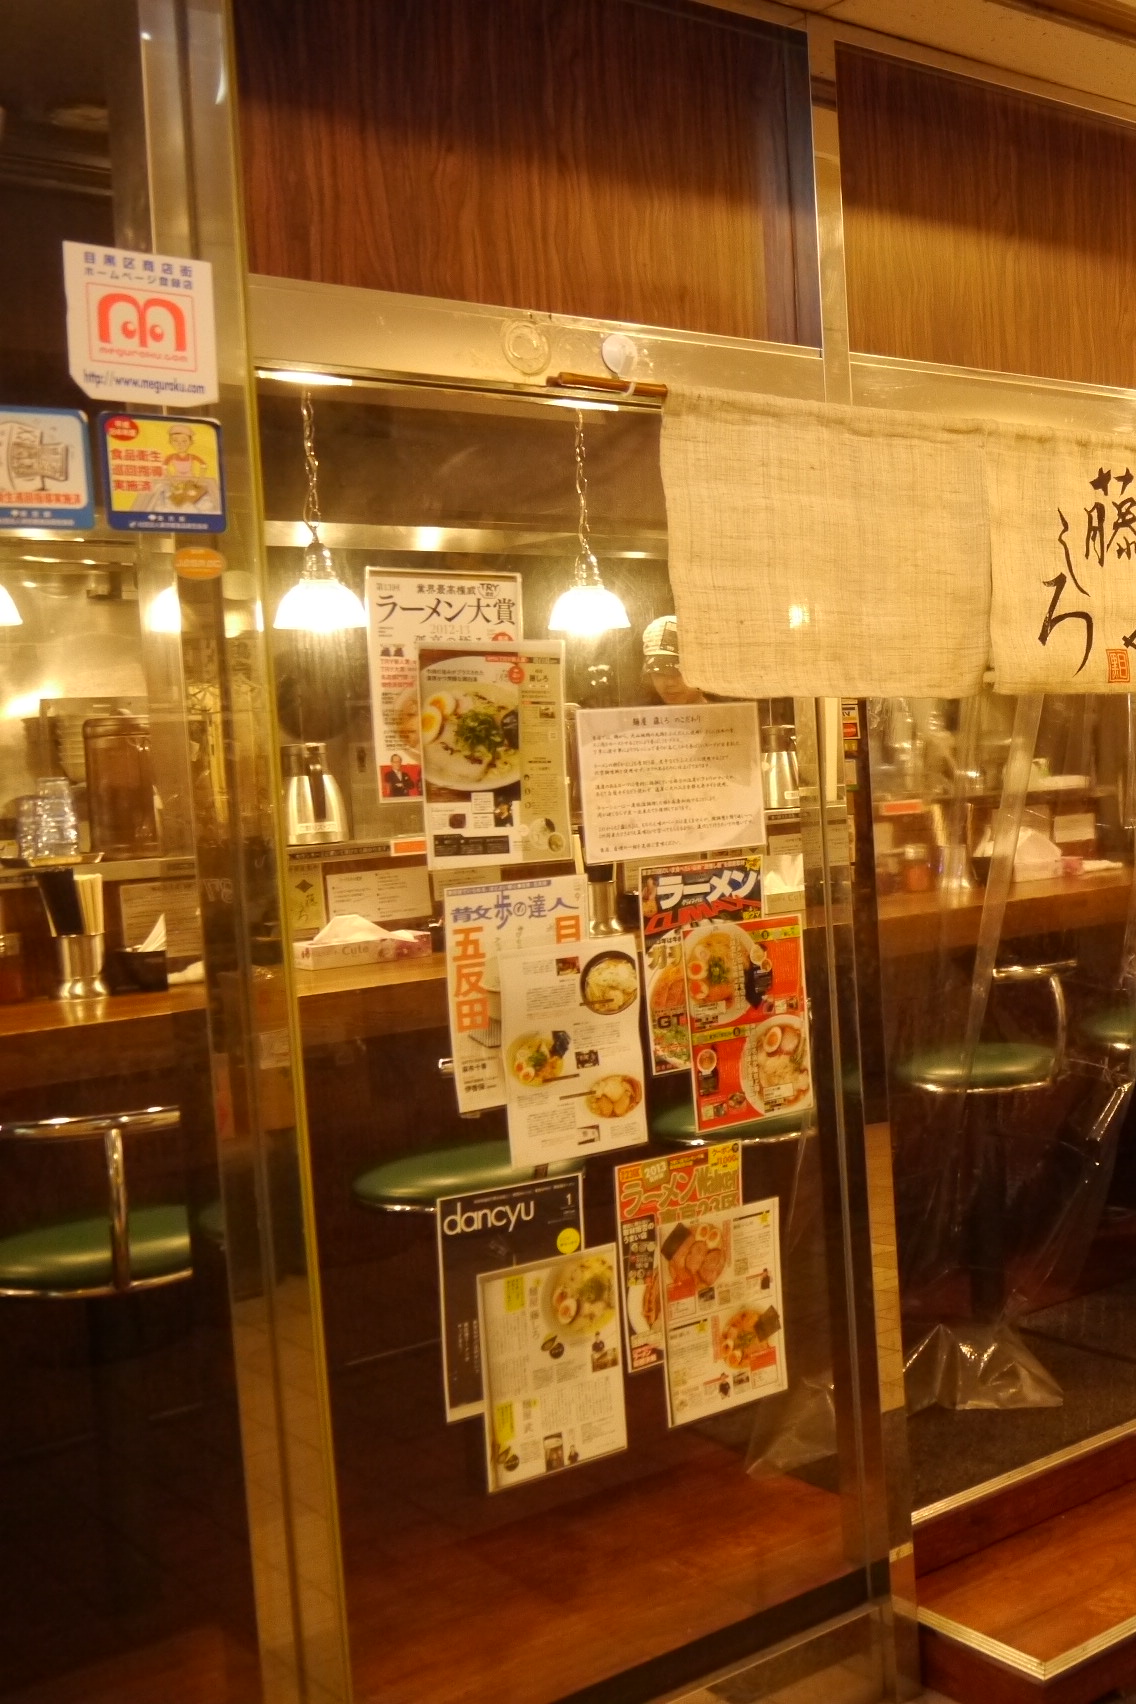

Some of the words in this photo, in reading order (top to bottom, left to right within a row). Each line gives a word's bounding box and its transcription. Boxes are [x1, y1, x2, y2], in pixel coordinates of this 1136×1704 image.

[83, 251, 193, 278] 目黒区商店街
[375, 594, 516, 626] ラーメン大賞
[656, 869, 758, 910] ラーメン
[451, 890, 580, 930] 散歩の達人
[452, 925, 492, 1034] 五反田
[566, 1193, 572, 1206] 1
[620, 1167, 699, 1218] ラーメン
[443, 1201, 535, 1236] dancyu
